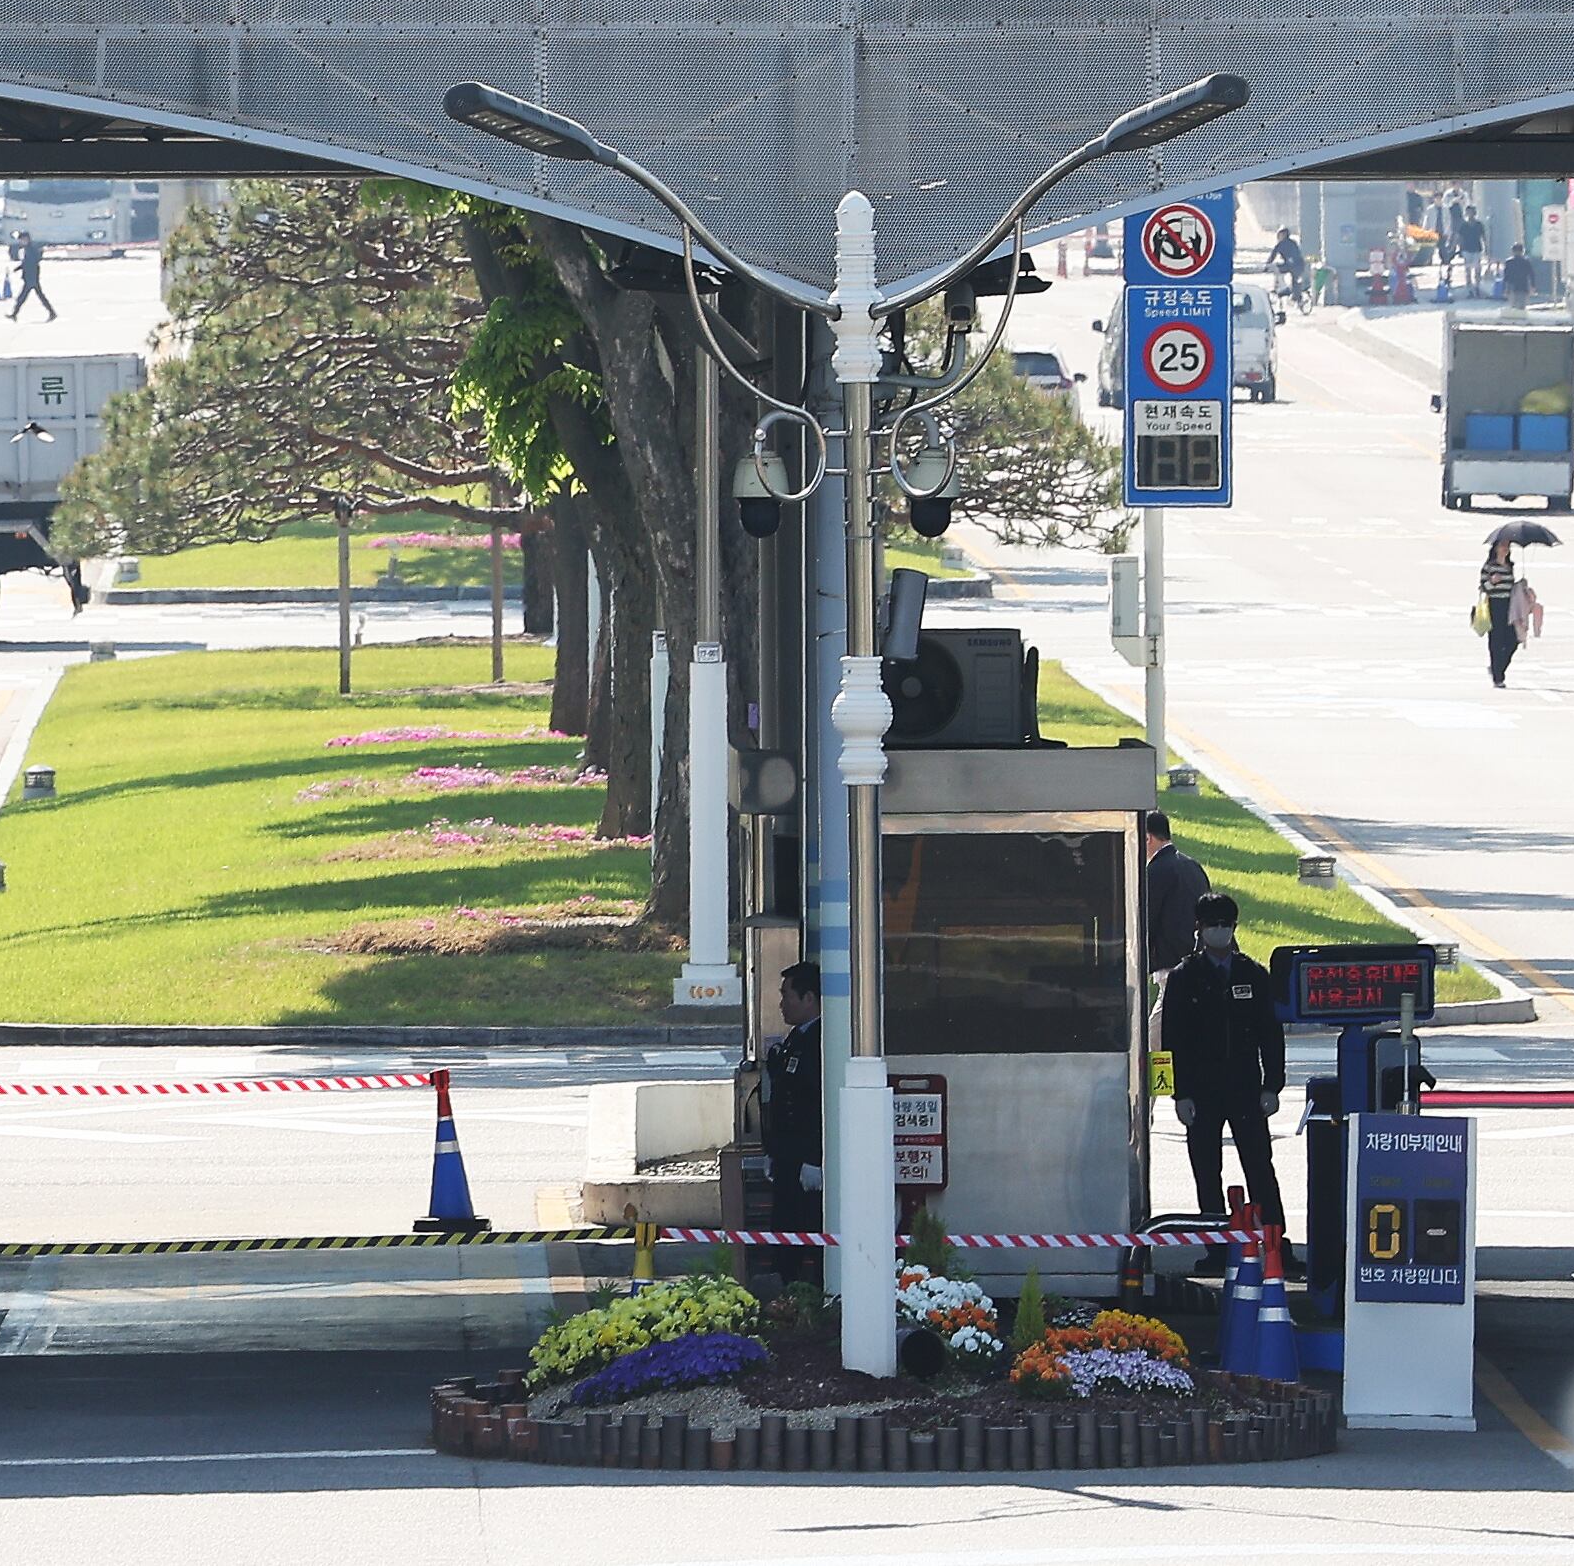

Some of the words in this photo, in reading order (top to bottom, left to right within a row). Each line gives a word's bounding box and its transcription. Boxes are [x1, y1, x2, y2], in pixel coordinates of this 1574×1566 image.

[1144, 290, 1212, 306] 규정속도
[1144, 307, 1179, 318] Speed
[1182, 307, 1212, 317] LIMIT
[1159, 343, 1200, 372] 25
[1145, 404, 1212, 419] 현재속도
[1146, 421, 1171, 431] Your
[1176, 421, 1212, 432] Speed
[967, 638, 1012, 647] SAMSUNG
[895, 1114, 933, 1127] 검색중!
[1366, 1133, 1463, 1153] 차량10부제안내
[894, 1151, 932, 1163] 보행자
[900, 1166, 928, 1179] 주의!
[1360, 1266, 1386, 1283] 번호
[1391, 1268, 1460, 1285] 차량입니다.
